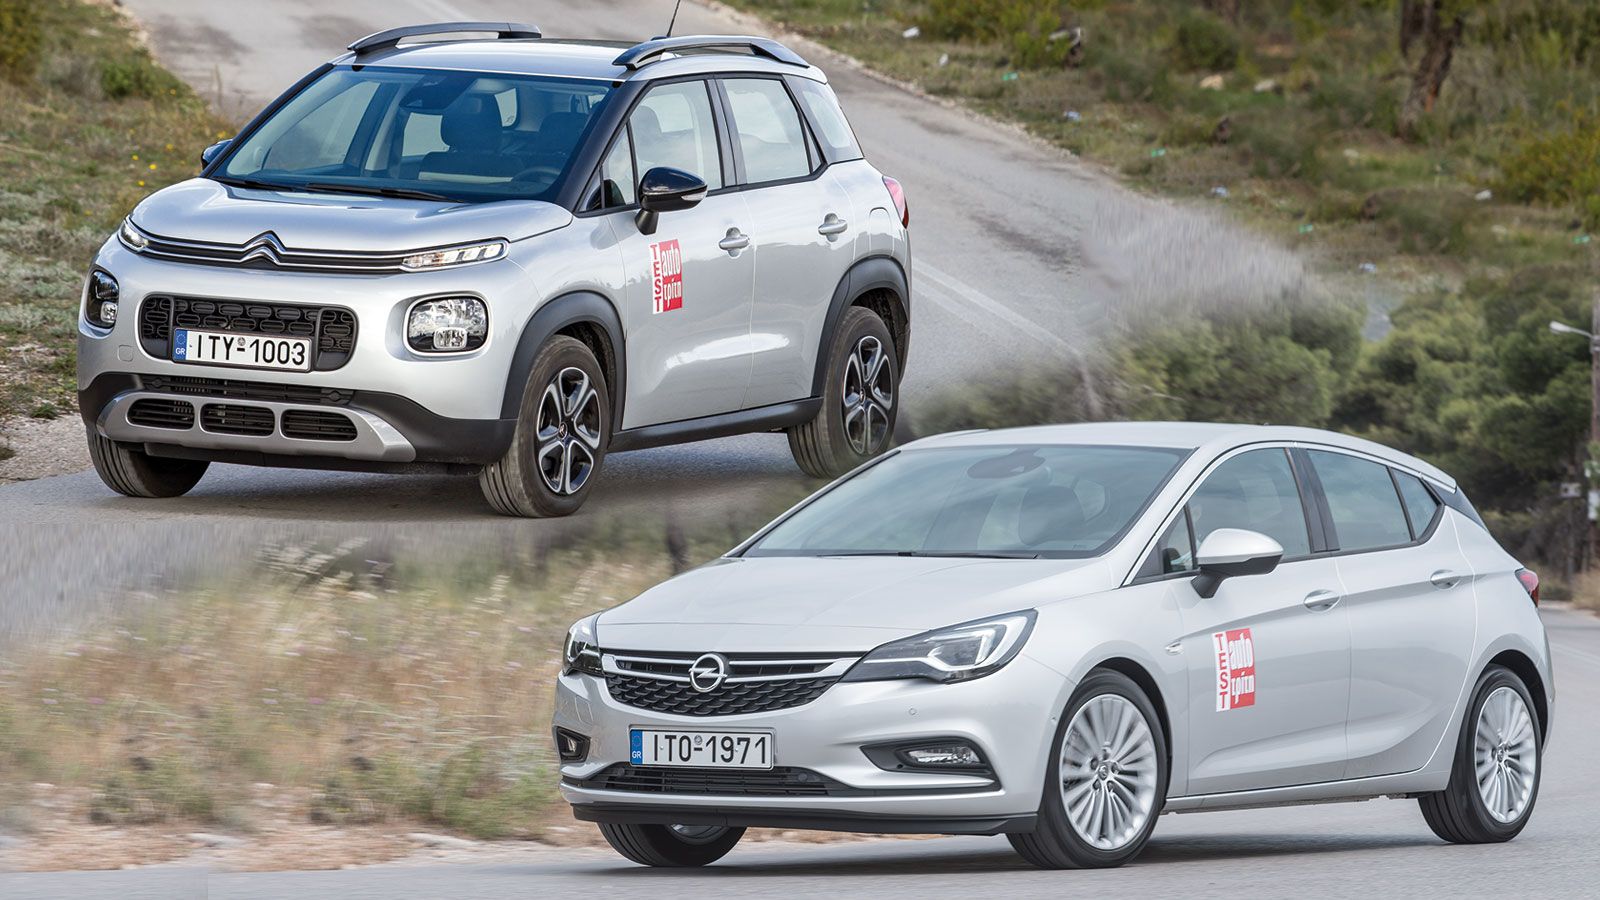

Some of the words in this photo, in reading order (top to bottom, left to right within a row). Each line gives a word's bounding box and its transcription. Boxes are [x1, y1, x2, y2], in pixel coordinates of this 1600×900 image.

[661, 242, 681, 277] auto
[650, 244, 662, 312] TEST
[175, 347, 186, 355] GR
[1228, 632, 1254, 670] auto
[1215, 633, 1228, 709] TEST
[631, 751, 642, 759] GR
